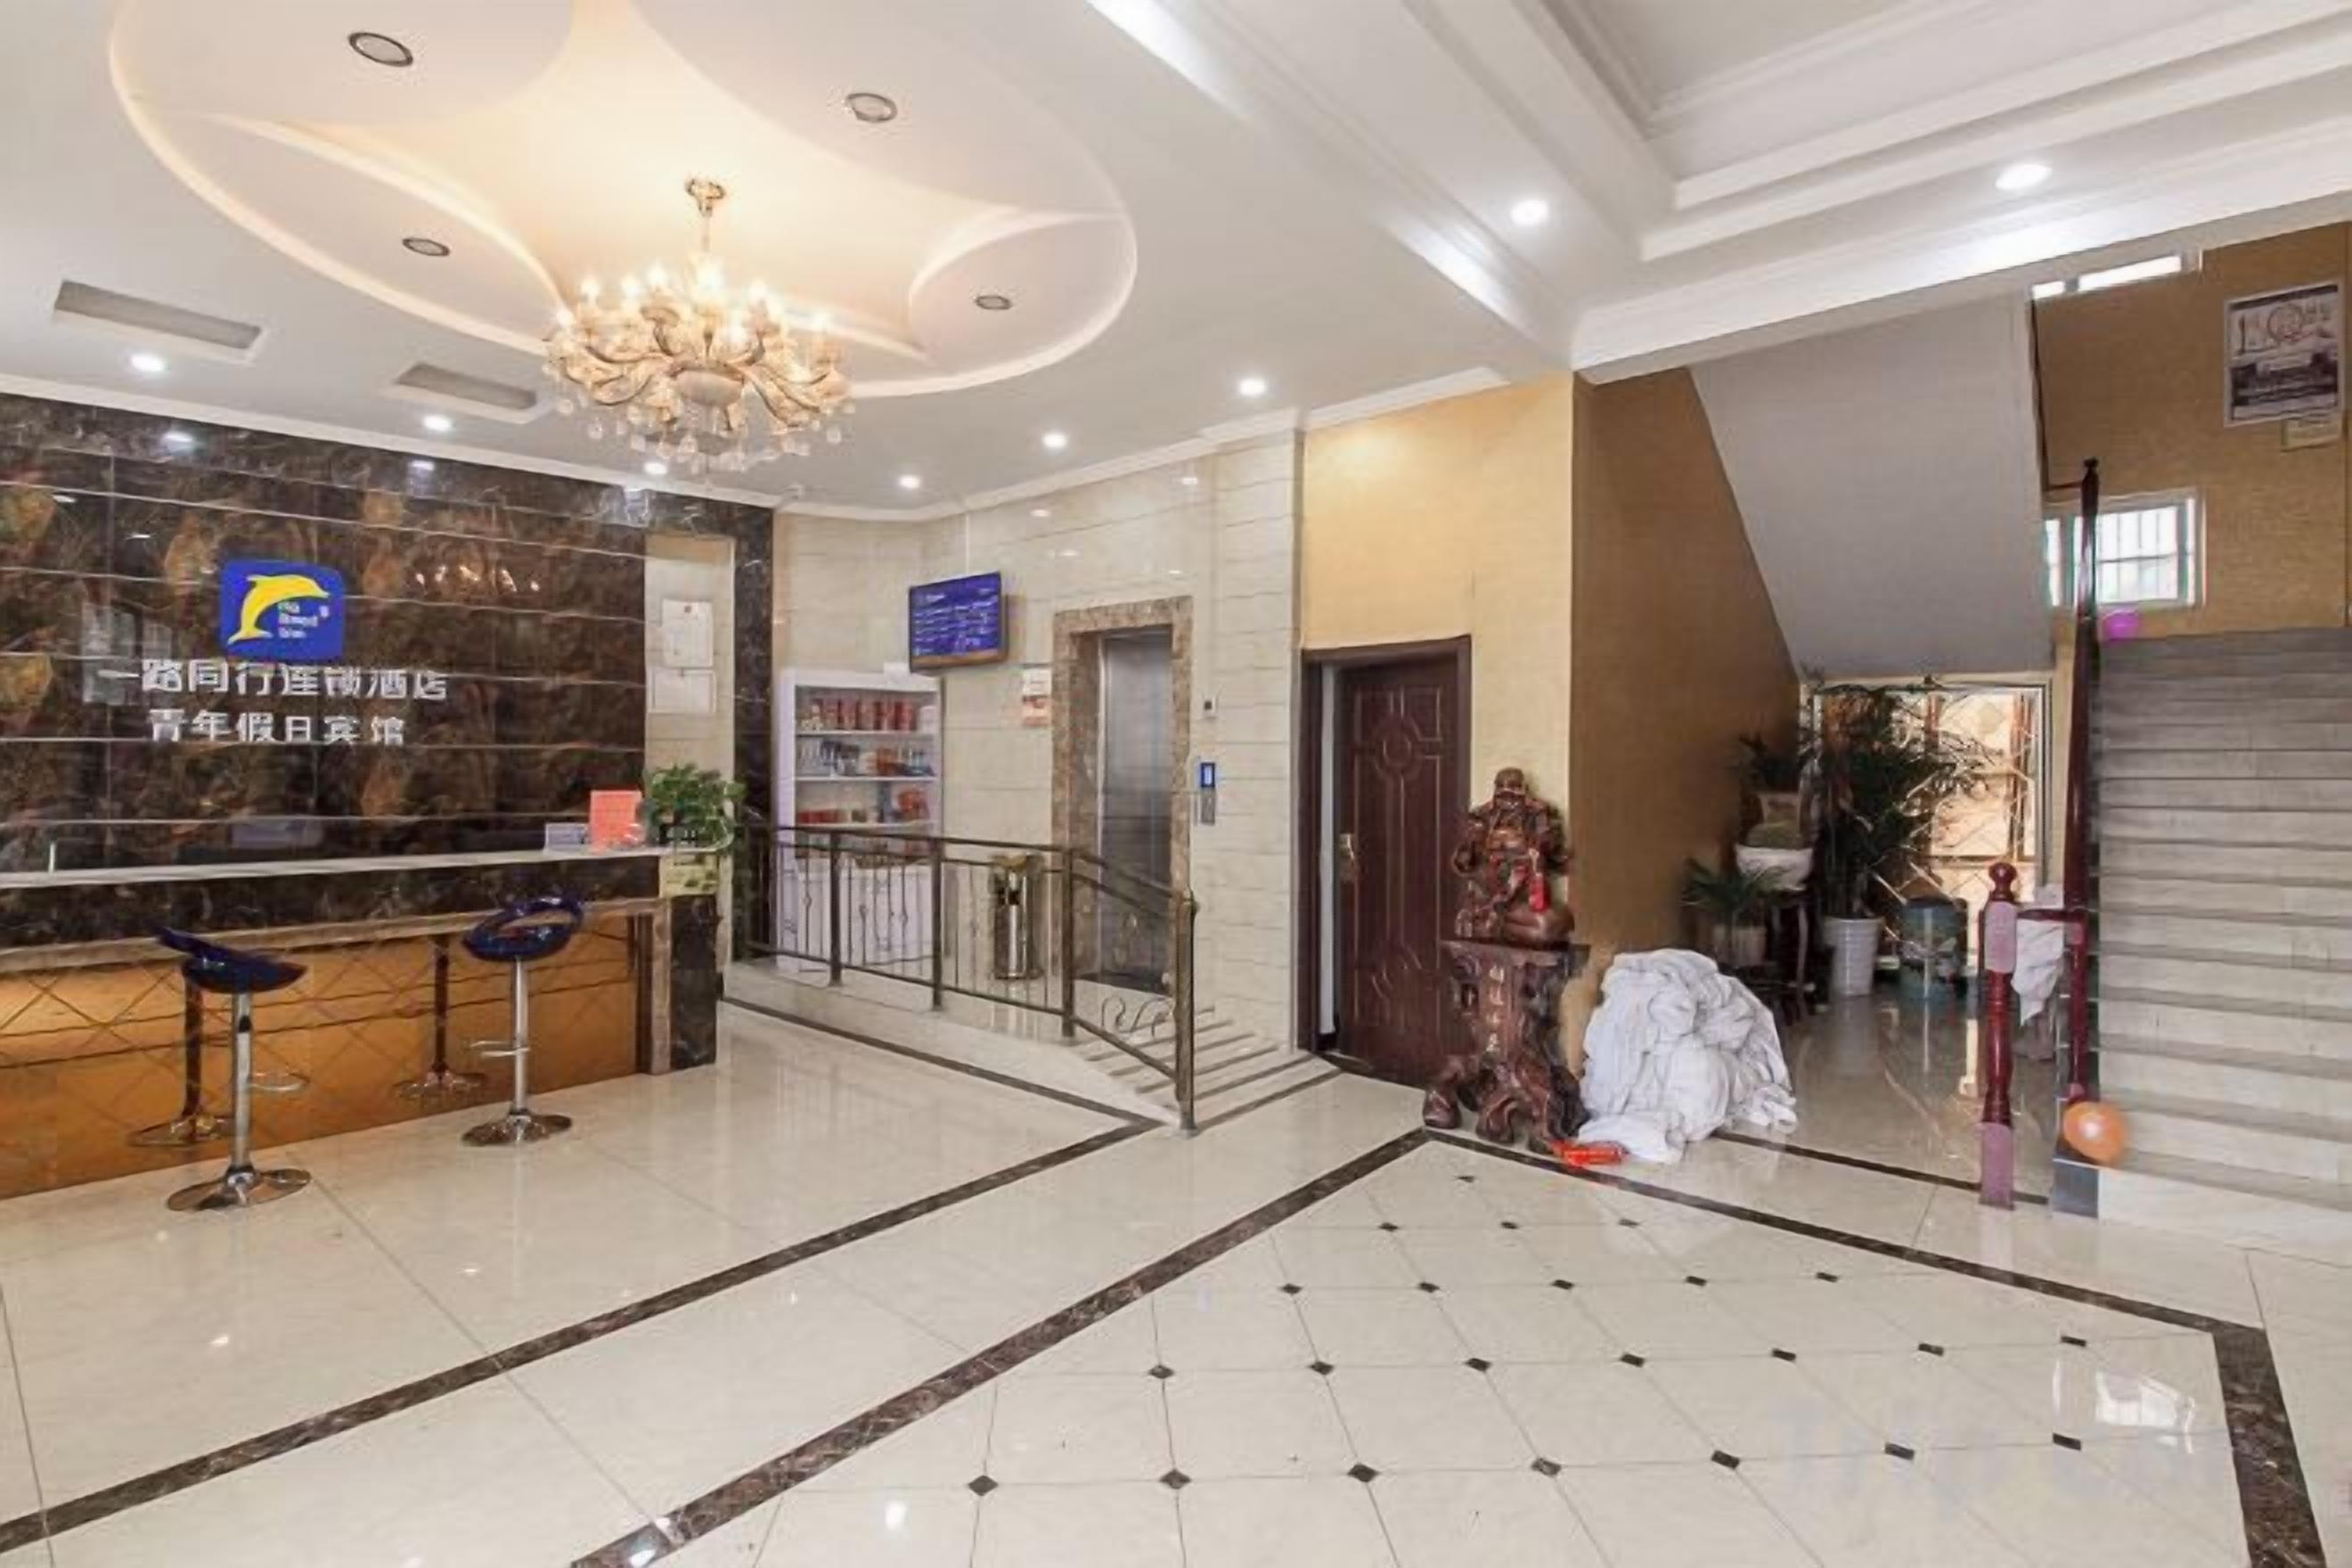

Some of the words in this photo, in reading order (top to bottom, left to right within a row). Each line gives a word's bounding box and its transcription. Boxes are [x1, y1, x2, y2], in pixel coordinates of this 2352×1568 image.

[149, 709, 405, 745] 青年假日宾馆
